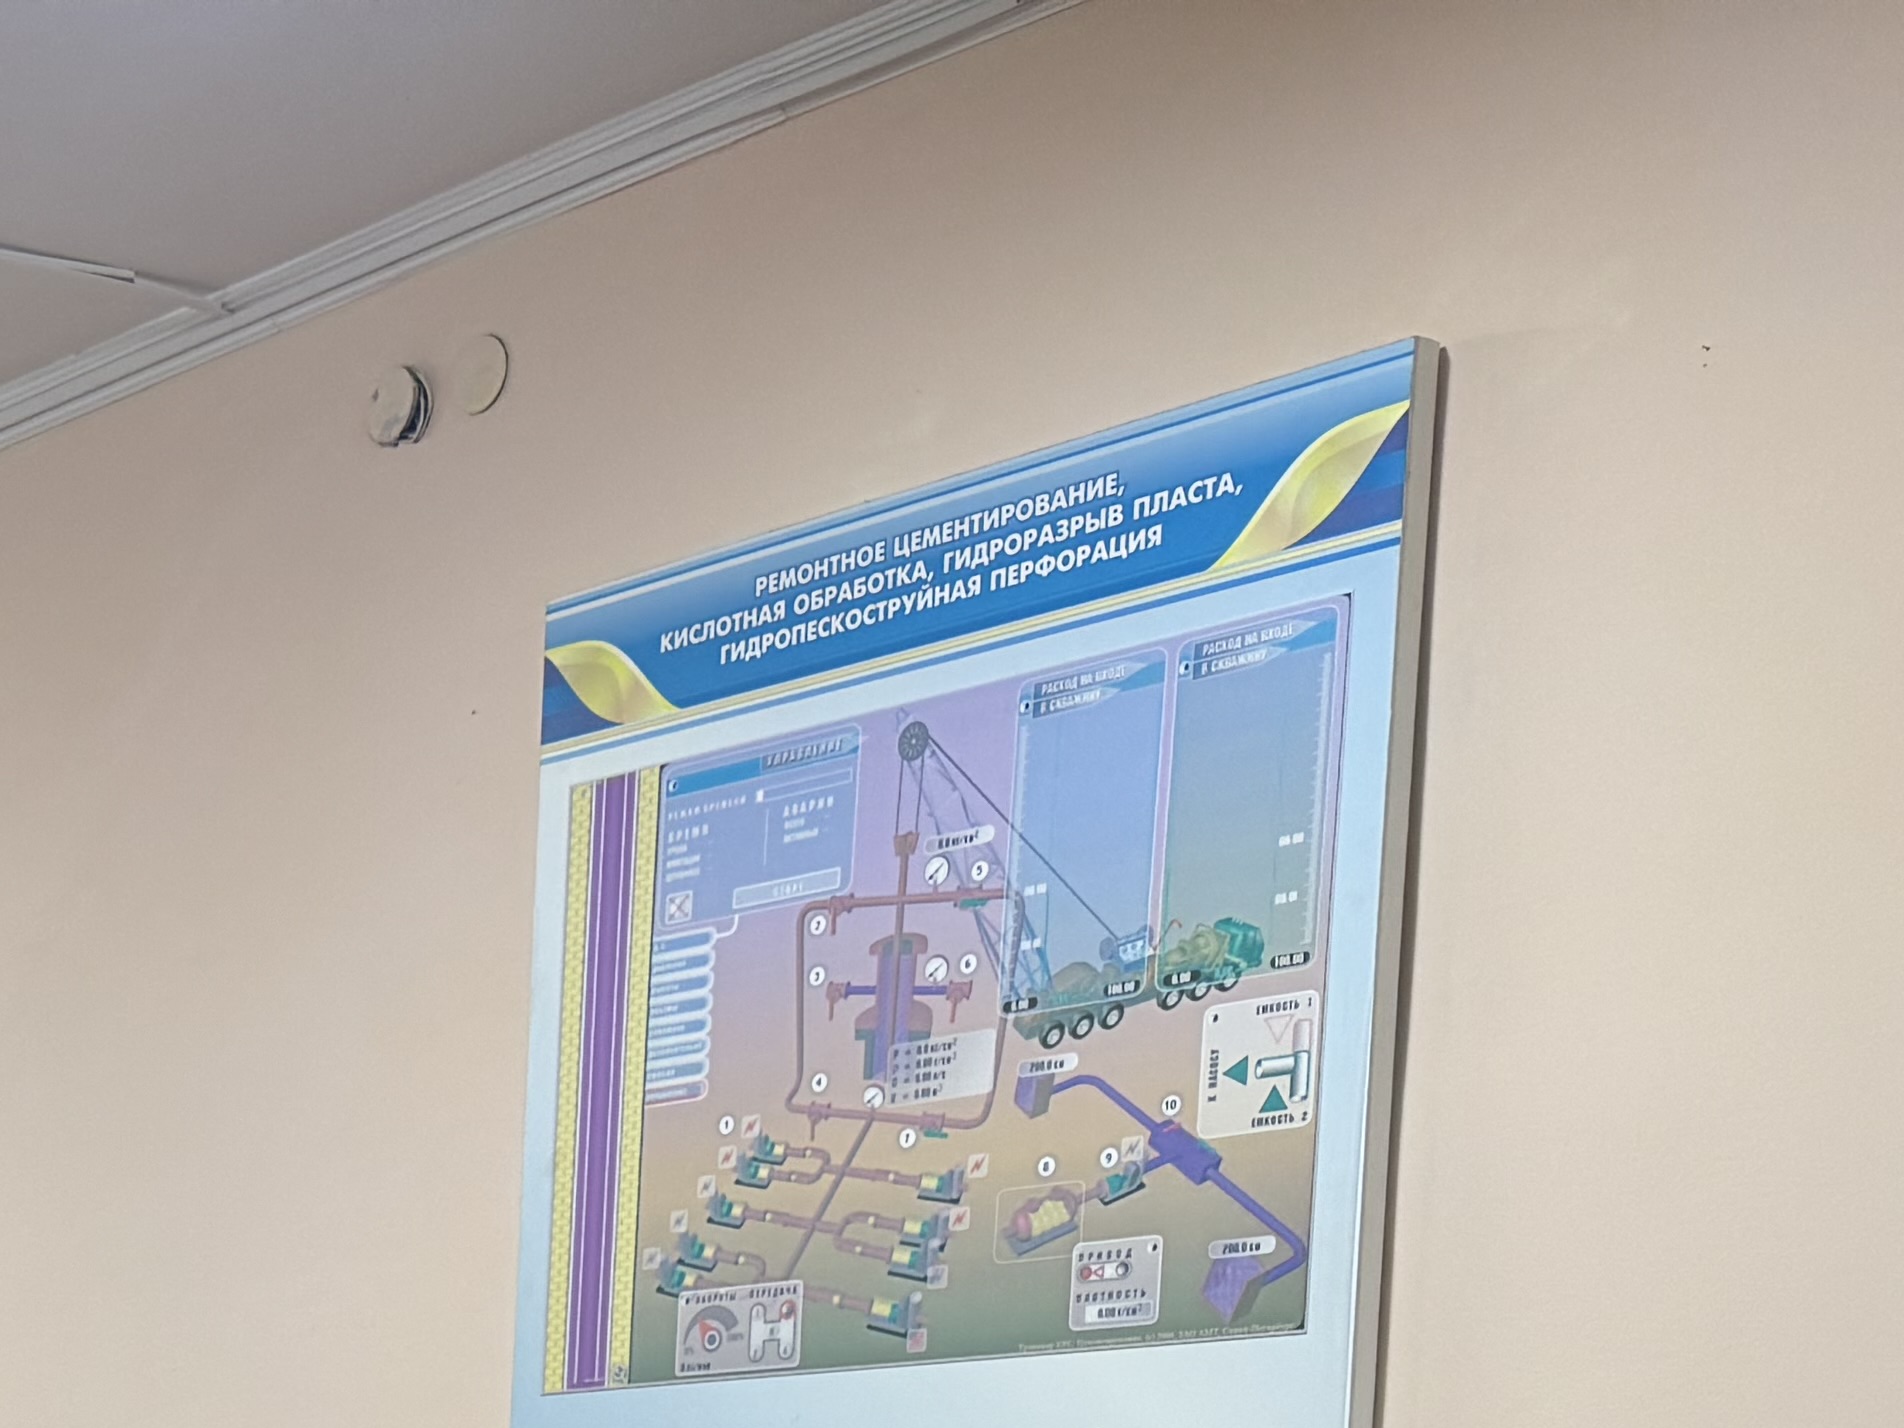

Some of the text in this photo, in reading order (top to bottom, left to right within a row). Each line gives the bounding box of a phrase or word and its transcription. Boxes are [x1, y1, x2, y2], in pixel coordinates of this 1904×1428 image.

[660, 472, 1244, 653] КИСЛОТНАЯ ОБРАБОТКА, ГИДРОРАЗРЫВ ПЛАСТА,
[755, 472, 1125, 597] РЕМОНТНОЕ ЦЕМЕНТИРОВАНИЕ,
[720, 524, 1163, 664] ГИДРОПЕСКОСТРУЙНАЯ ПЕРФОРАЦИЯ
[976, 864, 983, 876] 5
[1165, 1099, 1177, 1111] 10
[1104, 1152, 1113, 1164] 9
